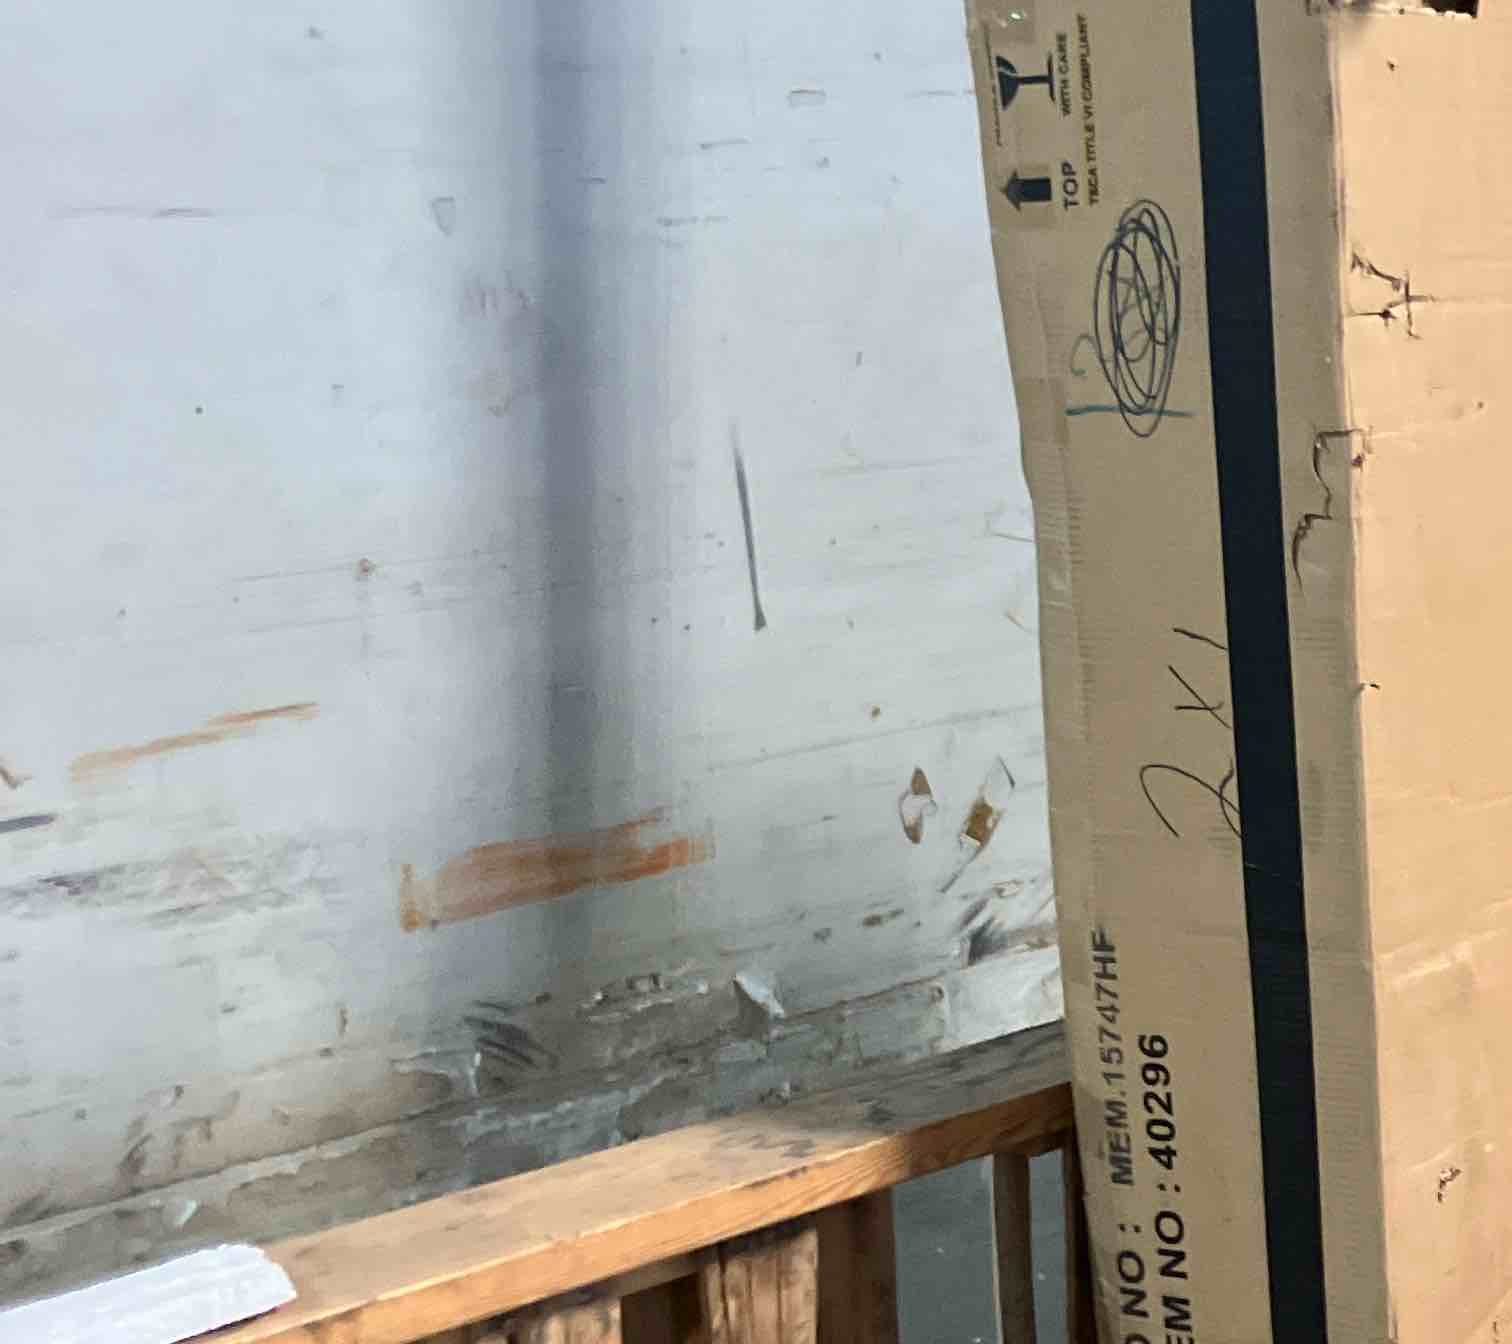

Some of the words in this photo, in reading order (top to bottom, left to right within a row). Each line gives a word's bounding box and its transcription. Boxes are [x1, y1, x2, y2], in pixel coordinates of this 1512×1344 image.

[1060, 80, 1071, 117] WITH
[1062, 160, 1080, 211] TOP
[1091, 928, 1134, 1187] MEM.15747HF
[1138, 1033, 1177, 1171] 40296
